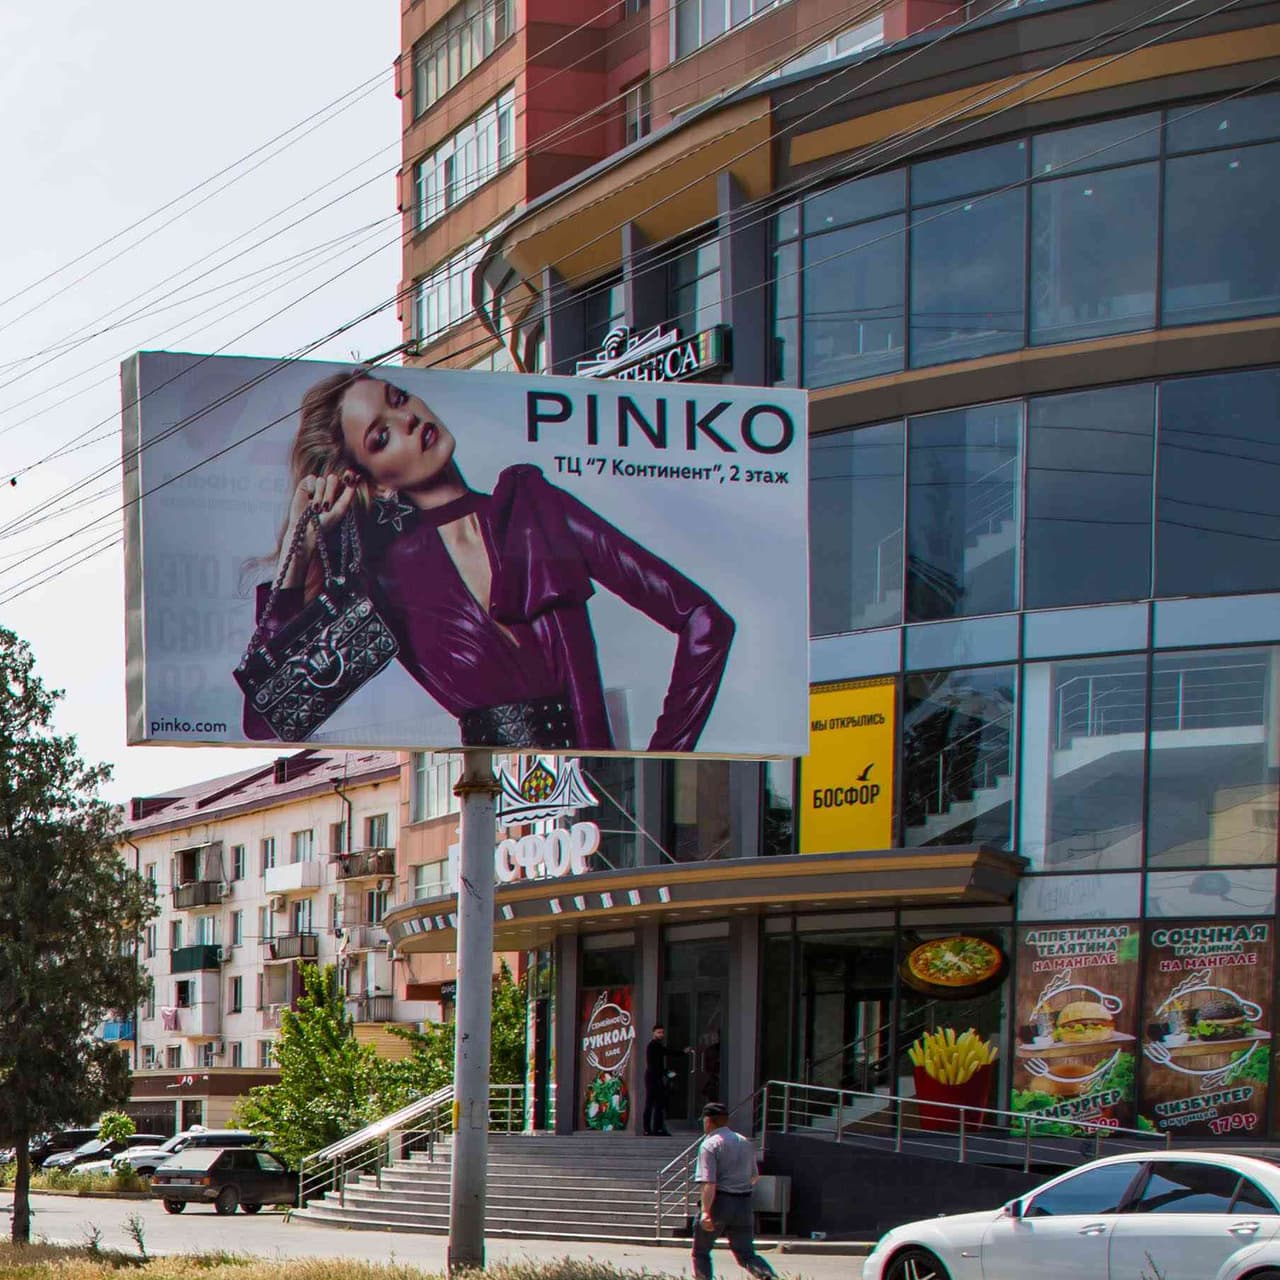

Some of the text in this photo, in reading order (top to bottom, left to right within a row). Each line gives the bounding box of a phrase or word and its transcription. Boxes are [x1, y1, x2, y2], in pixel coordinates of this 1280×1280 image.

[527, 391, 795, 455] PINKO
[554, 456, 582, 477] ТЦ
[729, 465, 740, 481] 2
[745, 469, 789, 484] этаж
[151, 717, 227, 735] pinko.com
[829, 713, 886, 730] ОТКРЫЛИСЬ
[813, 784, 880, 809] БОСФОР
[495, 821, 600, 882] СФОР
[1026, 926, 1129, 944] АППЕТИТНАЯ
[1038, 941, 1117, 956] ТЕЛЯТИНА
[1033, 953, 1117, 972] НА МАНГАЛЕ
[1160, 953, 1256, 972] НА МАНГАЛЕ
[583, 1025, 635, 1051] РУККОЛА
[1026, 1090, 1122, 1124] АМБУРГЕР
[1155, 1086, 1253, 1116] ЧИЗБУРГЕР
